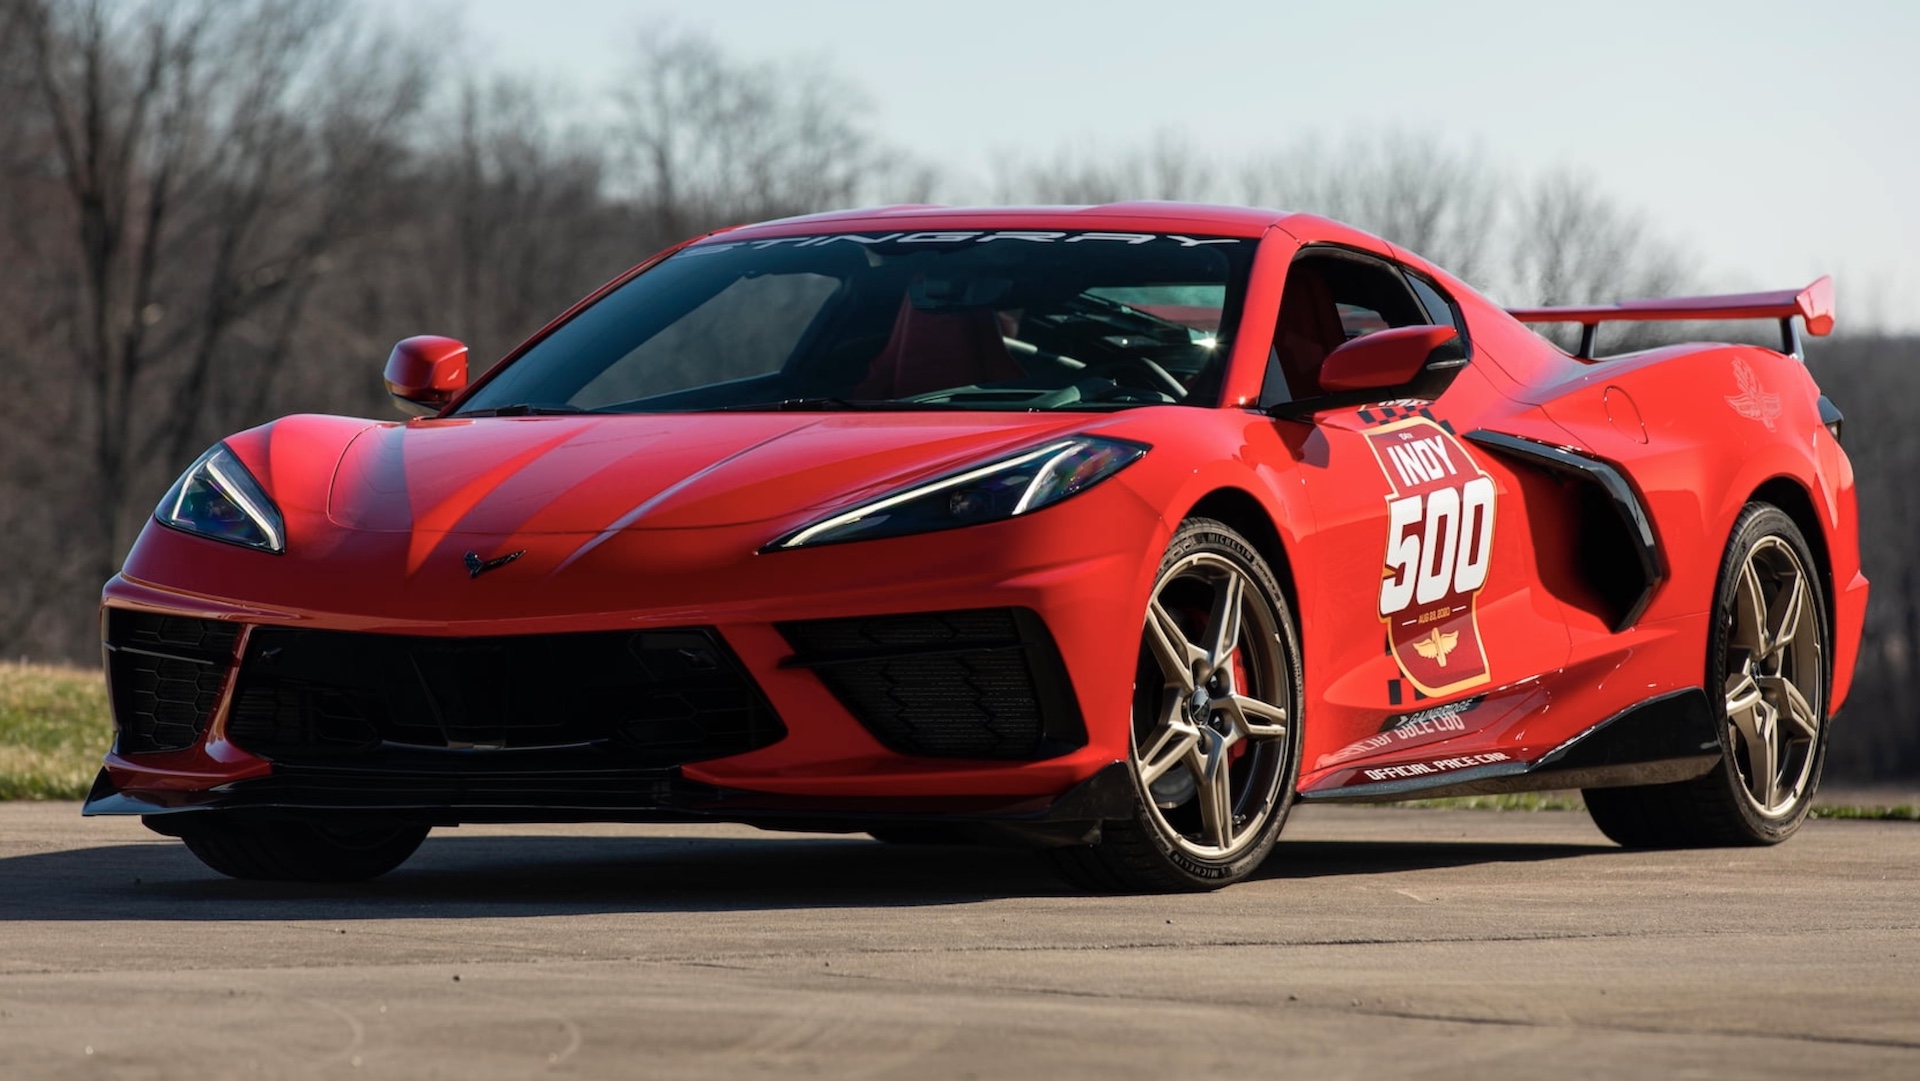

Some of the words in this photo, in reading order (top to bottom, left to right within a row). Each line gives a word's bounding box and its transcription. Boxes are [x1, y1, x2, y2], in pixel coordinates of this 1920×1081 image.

[680, 231, 1240, 258] STINGRAY
[1386, 435, 1457, 487] INDY
[1207, 532, 1252, 560] MICHELIN
[1380, 477, 1495, 615] 500
[1418, 612, 1430, 624] AUG
[1408, 698, 1473, 722] GAINBRIDGE
[1364, 763, 1437, 780] OFFICIAL
[1433, 756, 1477, 772] PACE
[1476, 751, 1512, 766] CAR
[1172, 853, 1220, 878] MICHELIN
